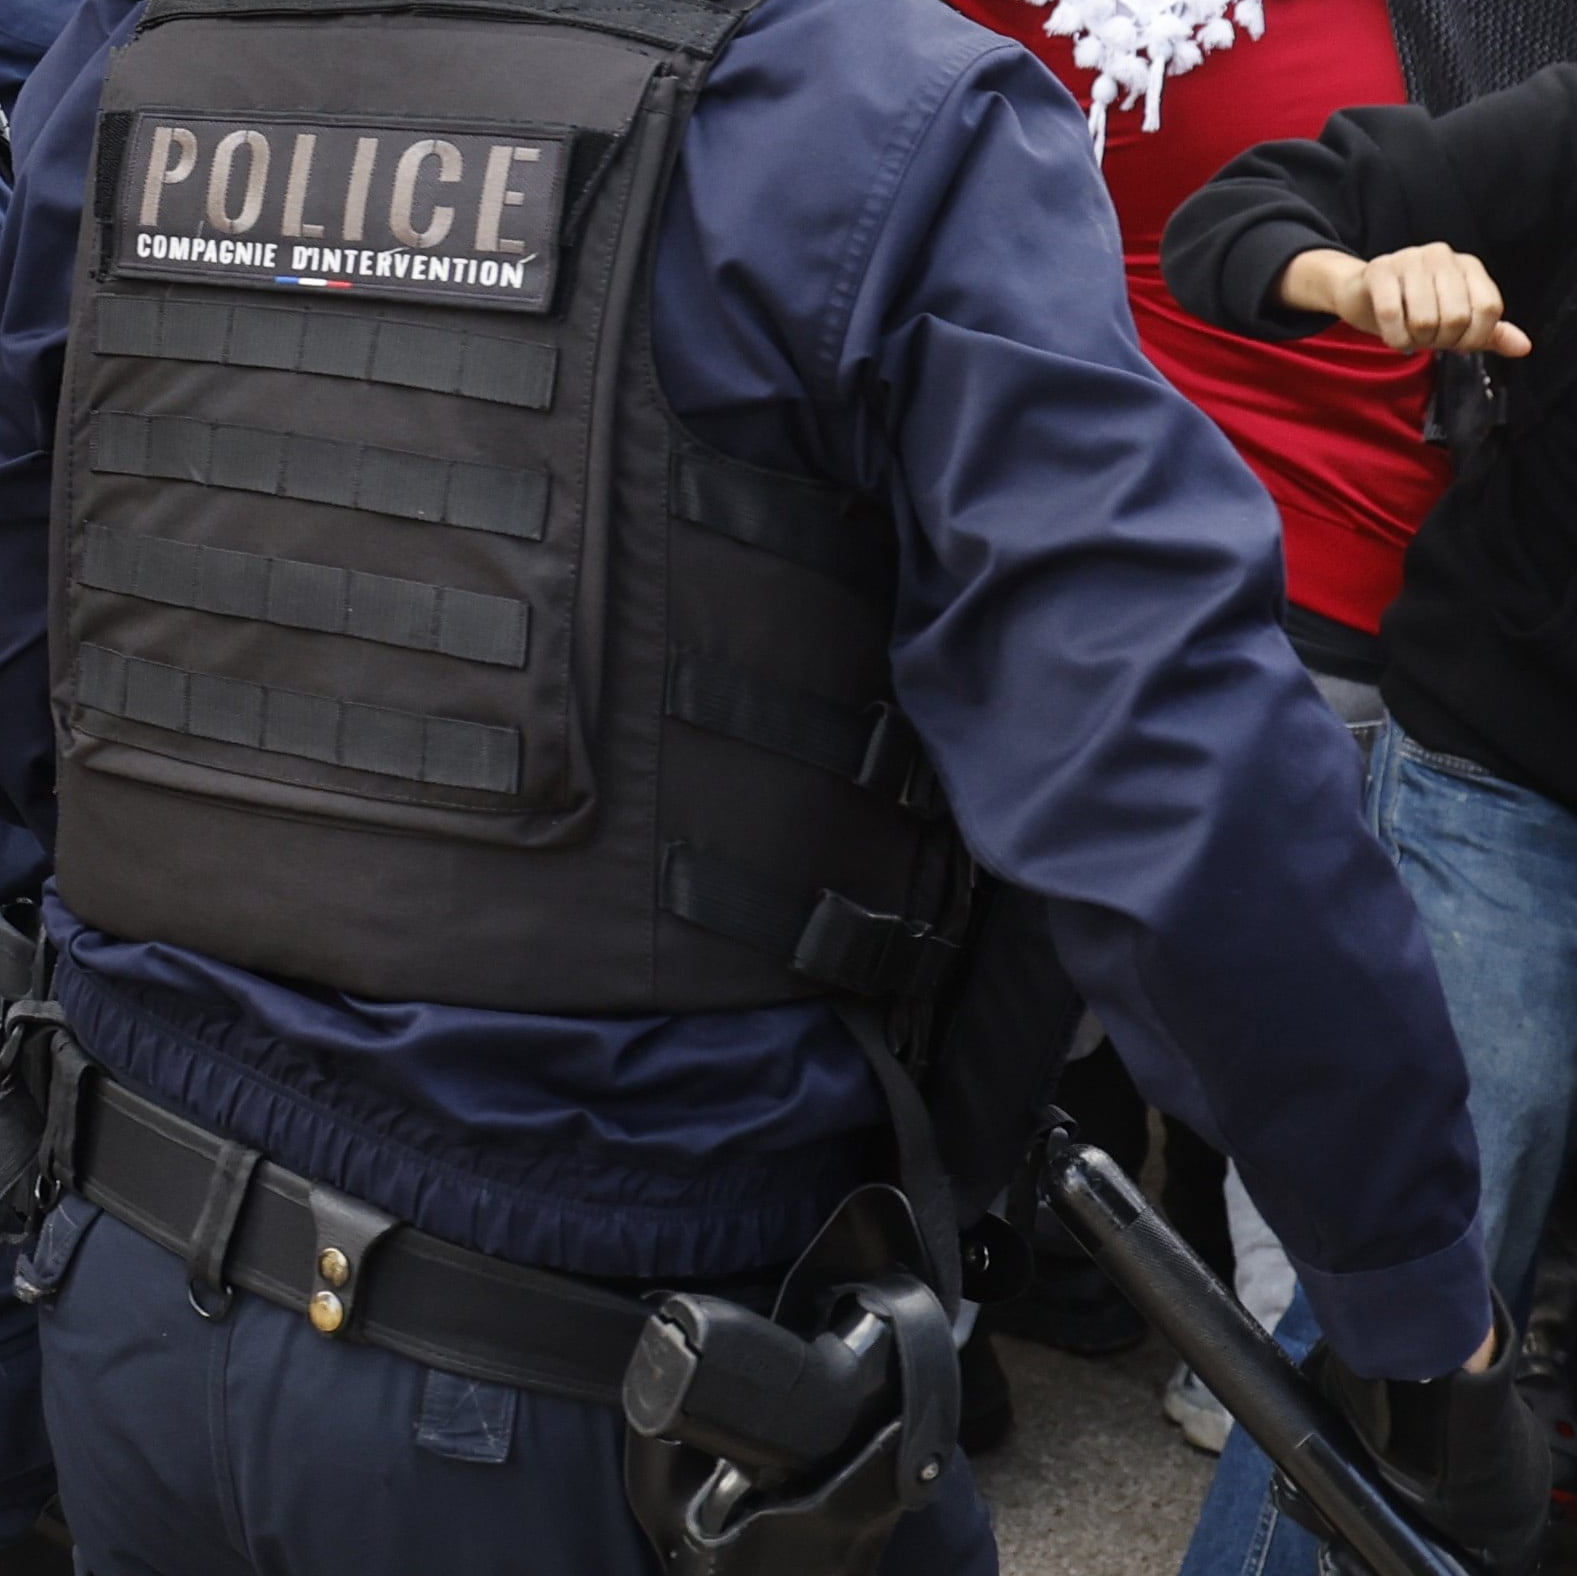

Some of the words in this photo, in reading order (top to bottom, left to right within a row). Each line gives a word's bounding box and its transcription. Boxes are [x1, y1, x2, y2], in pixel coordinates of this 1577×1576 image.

[138, 126, 541, 254] POLICE
[136, 232, 279, 268] COMPAGNIE
[290, 244, 525, 289] D'INTERVENTION
